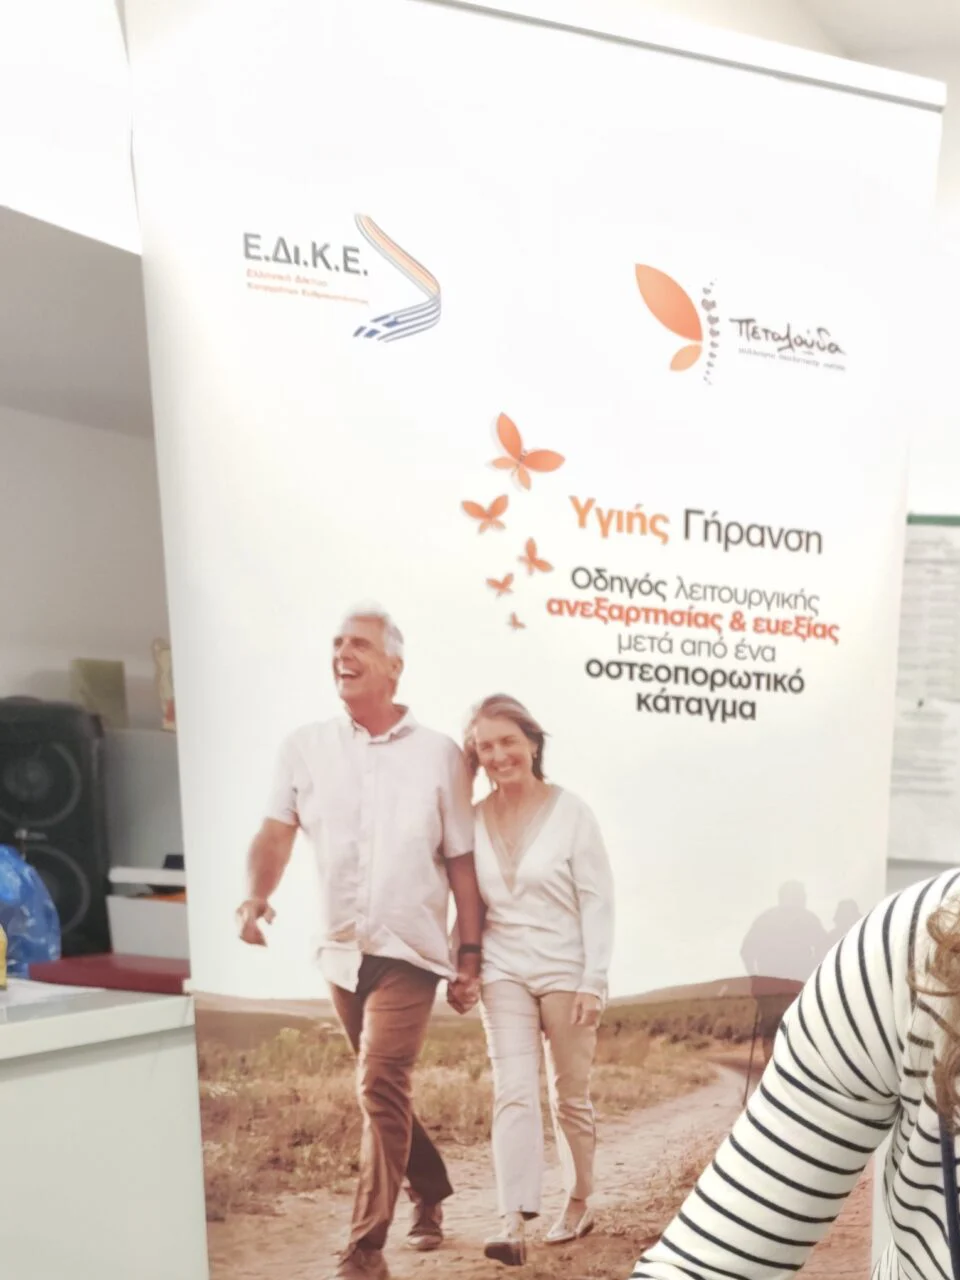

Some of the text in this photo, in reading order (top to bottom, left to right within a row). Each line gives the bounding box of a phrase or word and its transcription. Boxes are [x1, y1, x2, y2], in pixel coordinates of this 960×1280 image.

[569, 495, 824, 555] Υγιής Γήρανση
[571, 566, 820, 616] Οδηγός λειτουργικής
[546, 596, 840, 646] ανεξαρτησίας & ευεξίας
[617, 631, 777, 664] μετά από ένα
[585, 658, 805, 694] οστεοπορωτικό
[636, 687, 757, 723] κάταγμα
